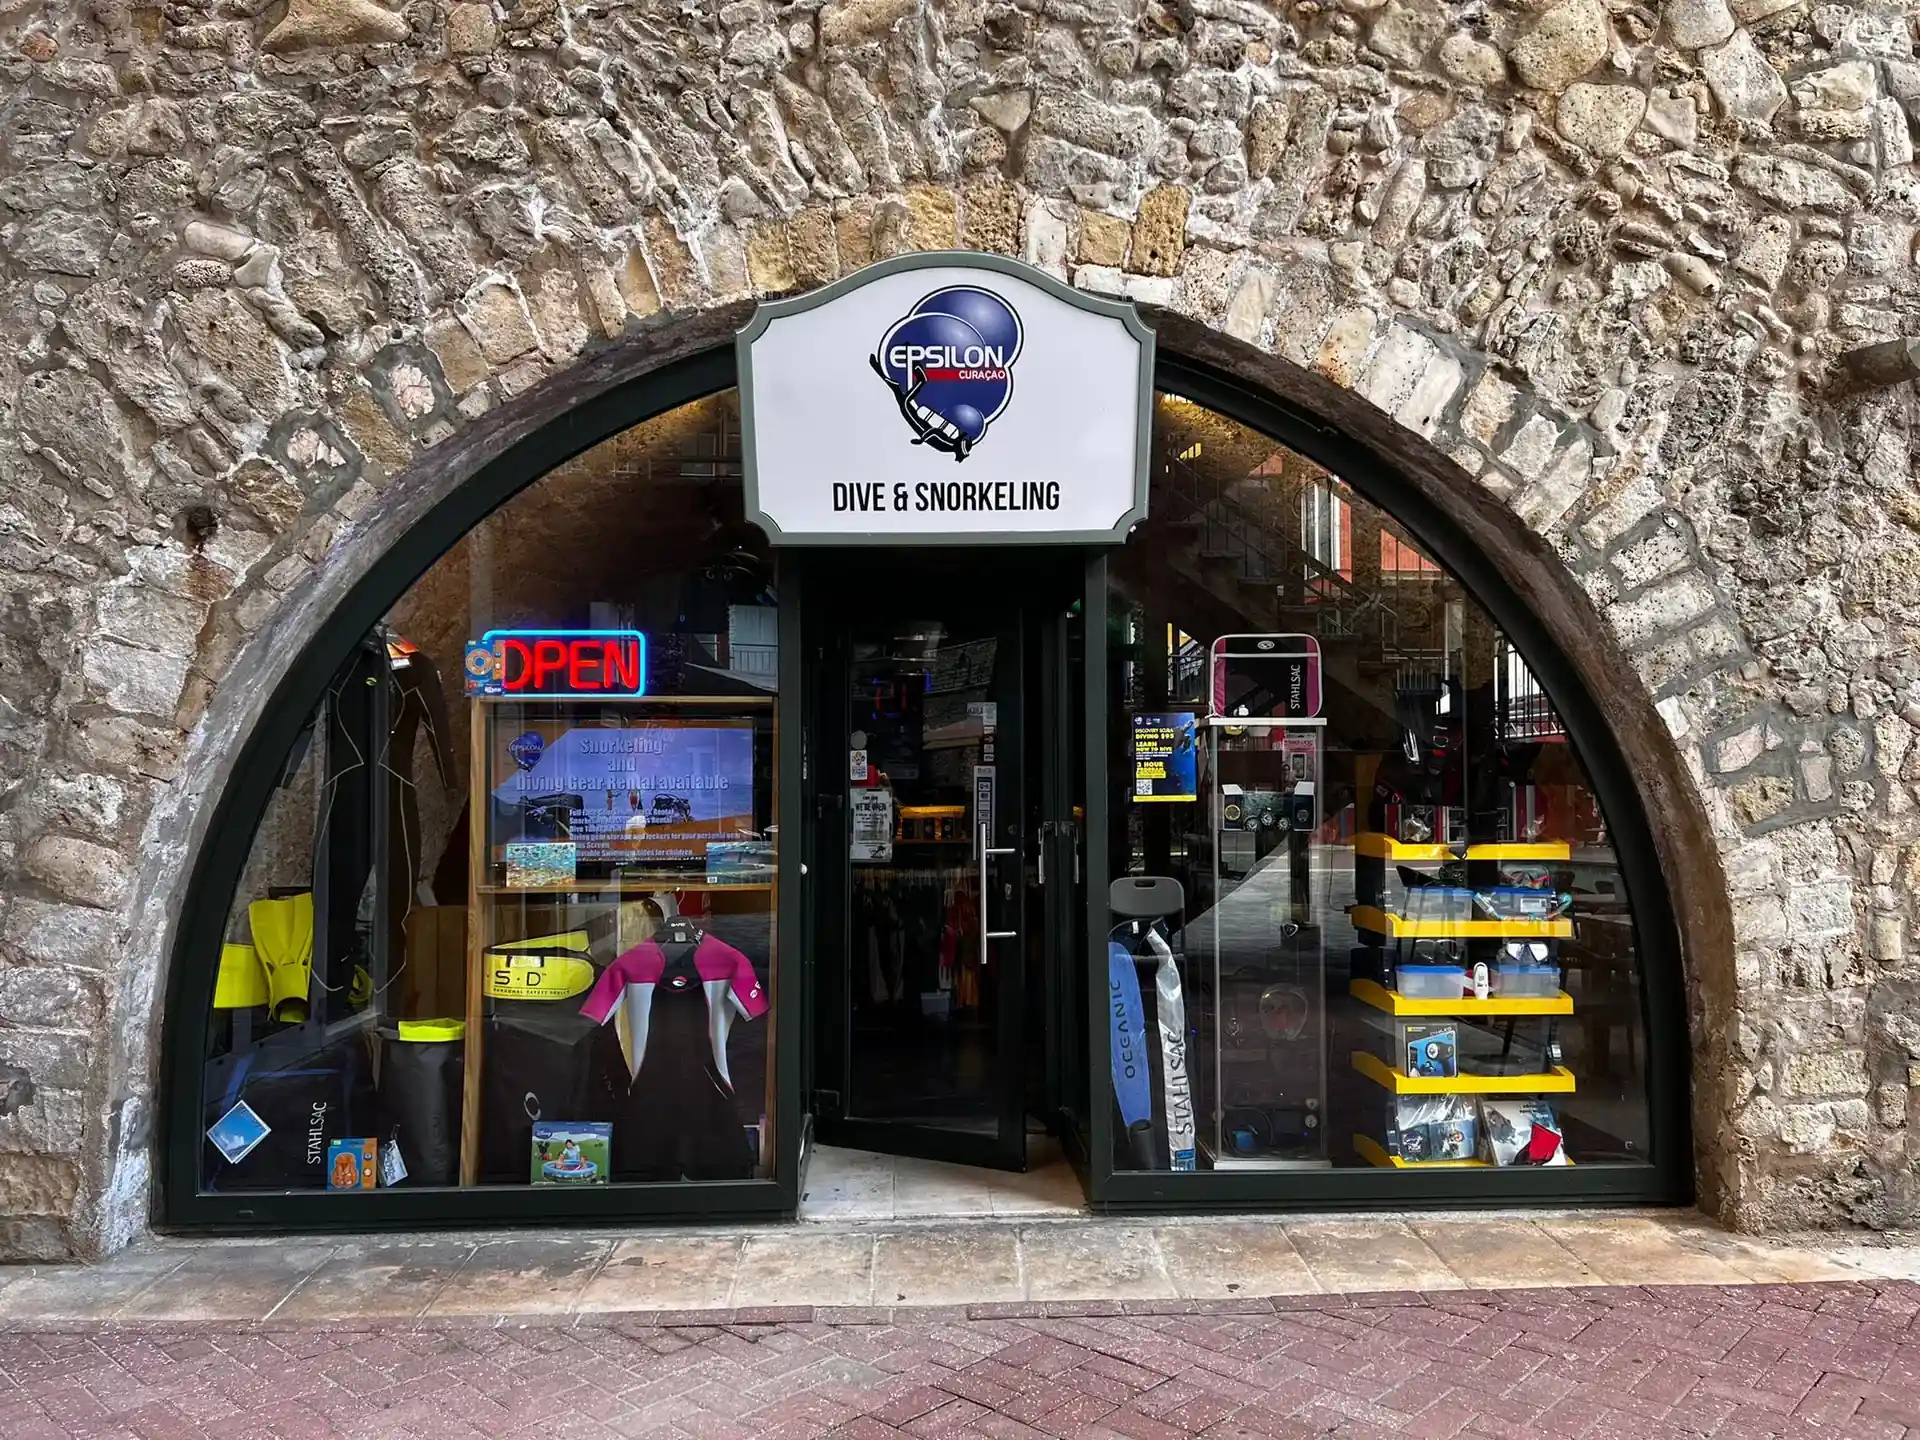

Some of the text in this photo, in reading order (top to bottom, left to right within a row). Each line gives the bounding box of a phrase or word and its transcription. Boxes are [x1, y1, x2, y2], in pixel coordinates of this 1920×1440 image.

[889, 344, 1003, 372] EPSILON
[958, 369, 1006, 381] CURAÇAO
[833, 481, 1060, 512] DIVE & SNORKELING
[503, 640, 640, 690] OPEN
[1290, 664, 1301, 710] STAHLSAC
[580, 737, 664, 755] Snorkeling
[607, 758, 636, 771] and
[516, 774, 730, 792] Diving Gear Rental available
[1110, 980, 1136, 1078] OCEANIC
[306, 1102, 327, 1164] STAHLSAC
